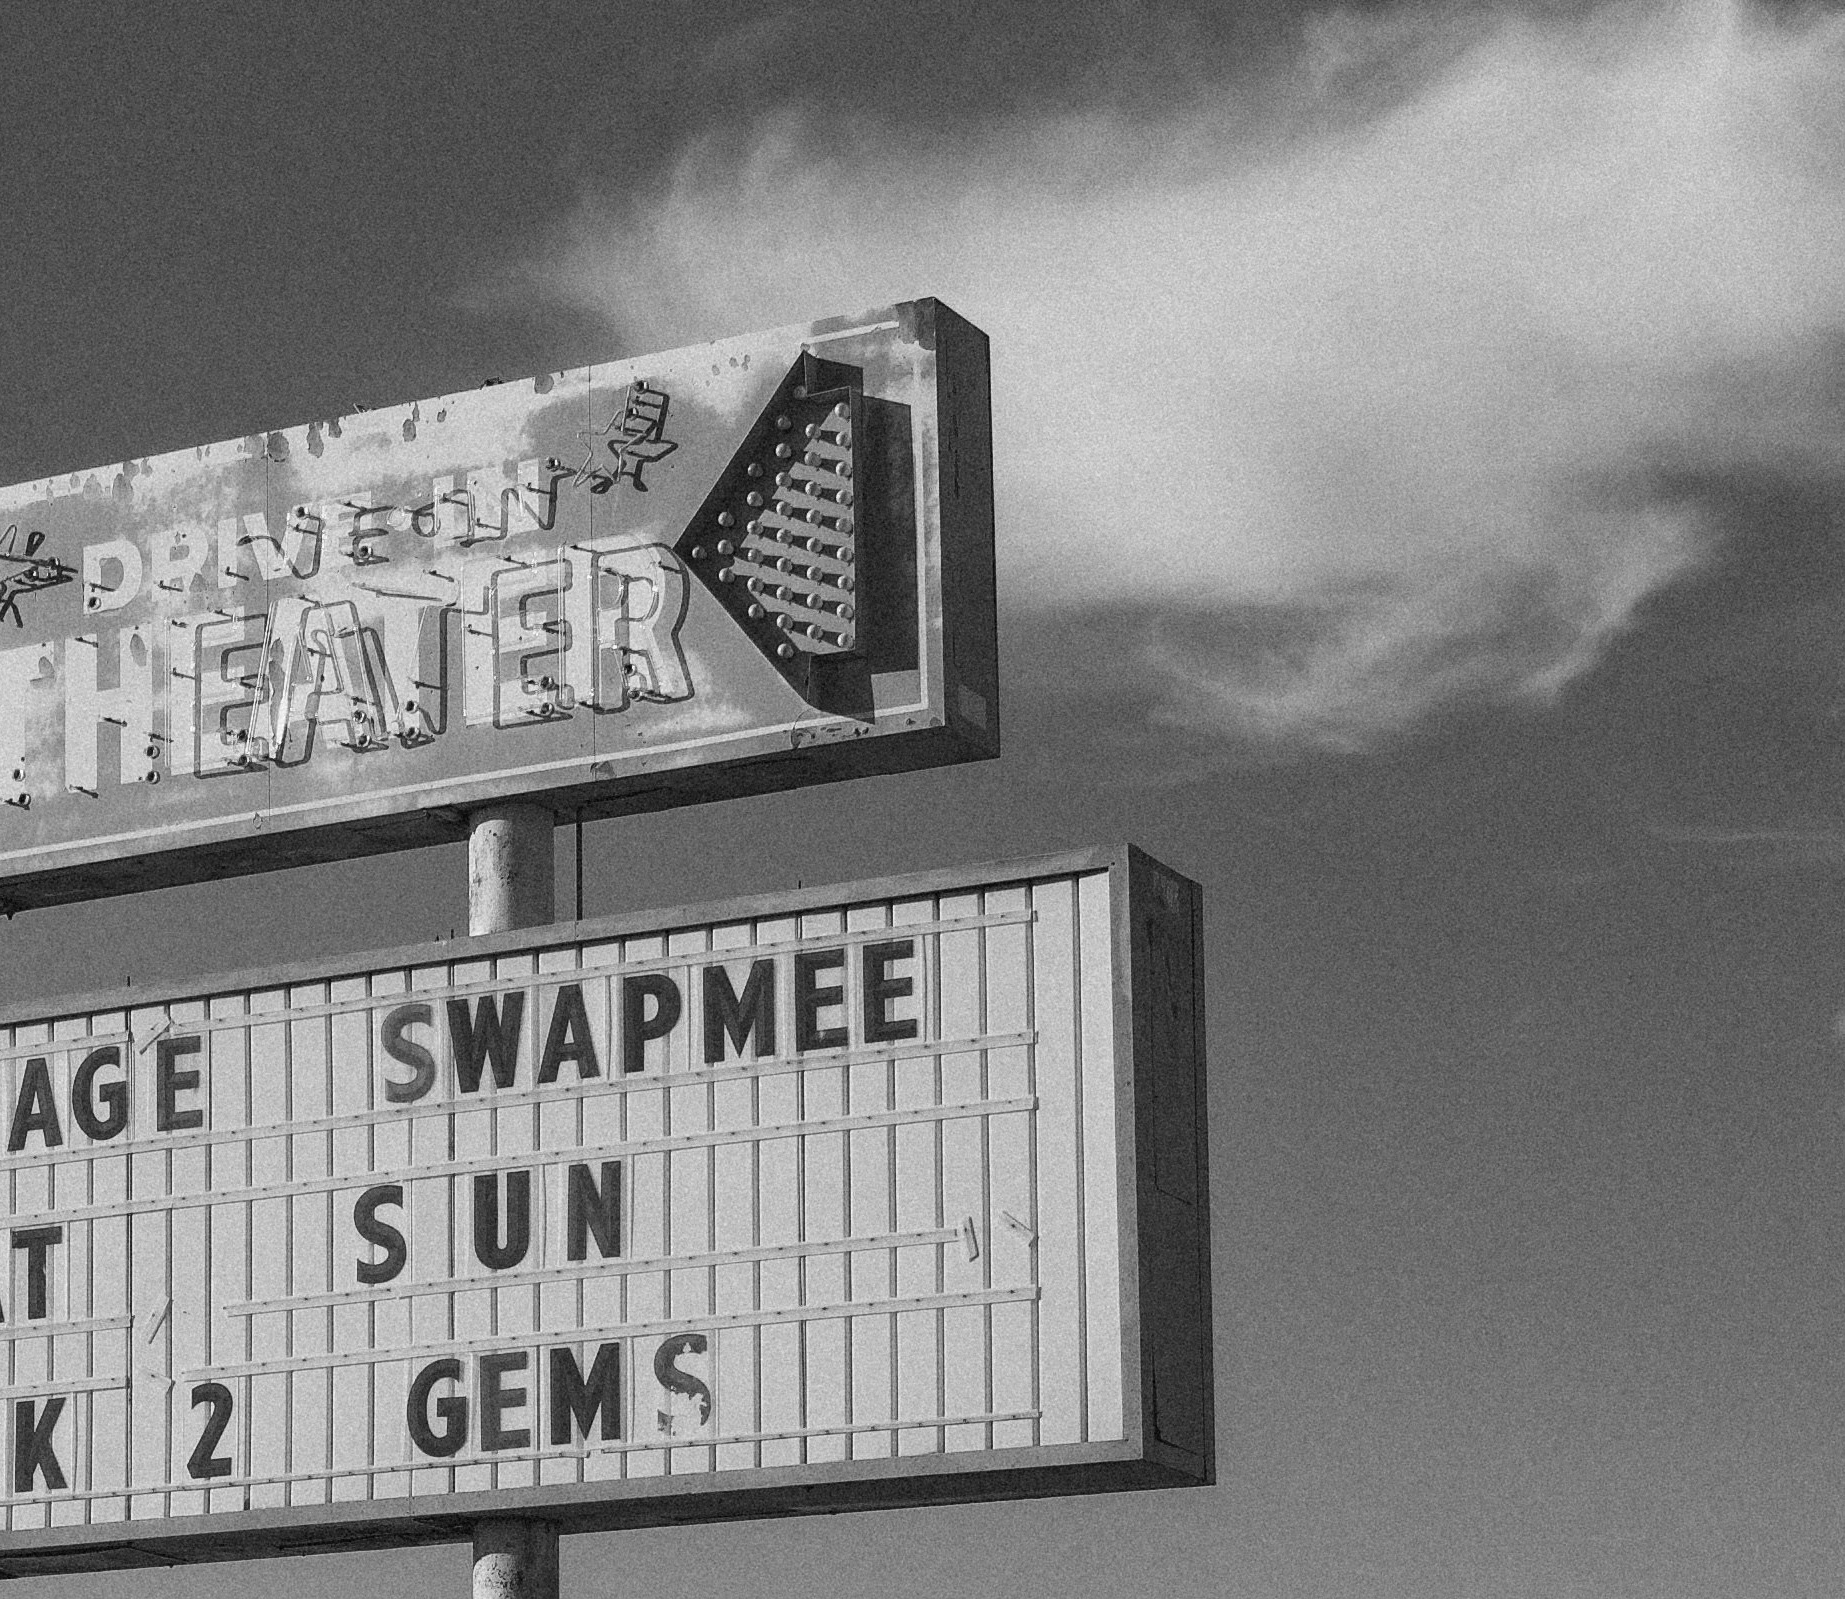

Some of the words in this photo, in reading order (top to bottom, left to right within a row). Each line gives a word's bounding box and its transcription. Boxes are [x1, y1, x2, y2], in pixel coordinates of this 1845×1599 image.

[380, 939, 918, 1104] SWAPMEE
[354, 1160, 623, 1285] SUN
[186, 1382, 234, 1480] 2
[406, 1333, 713, 1458] GEMS
